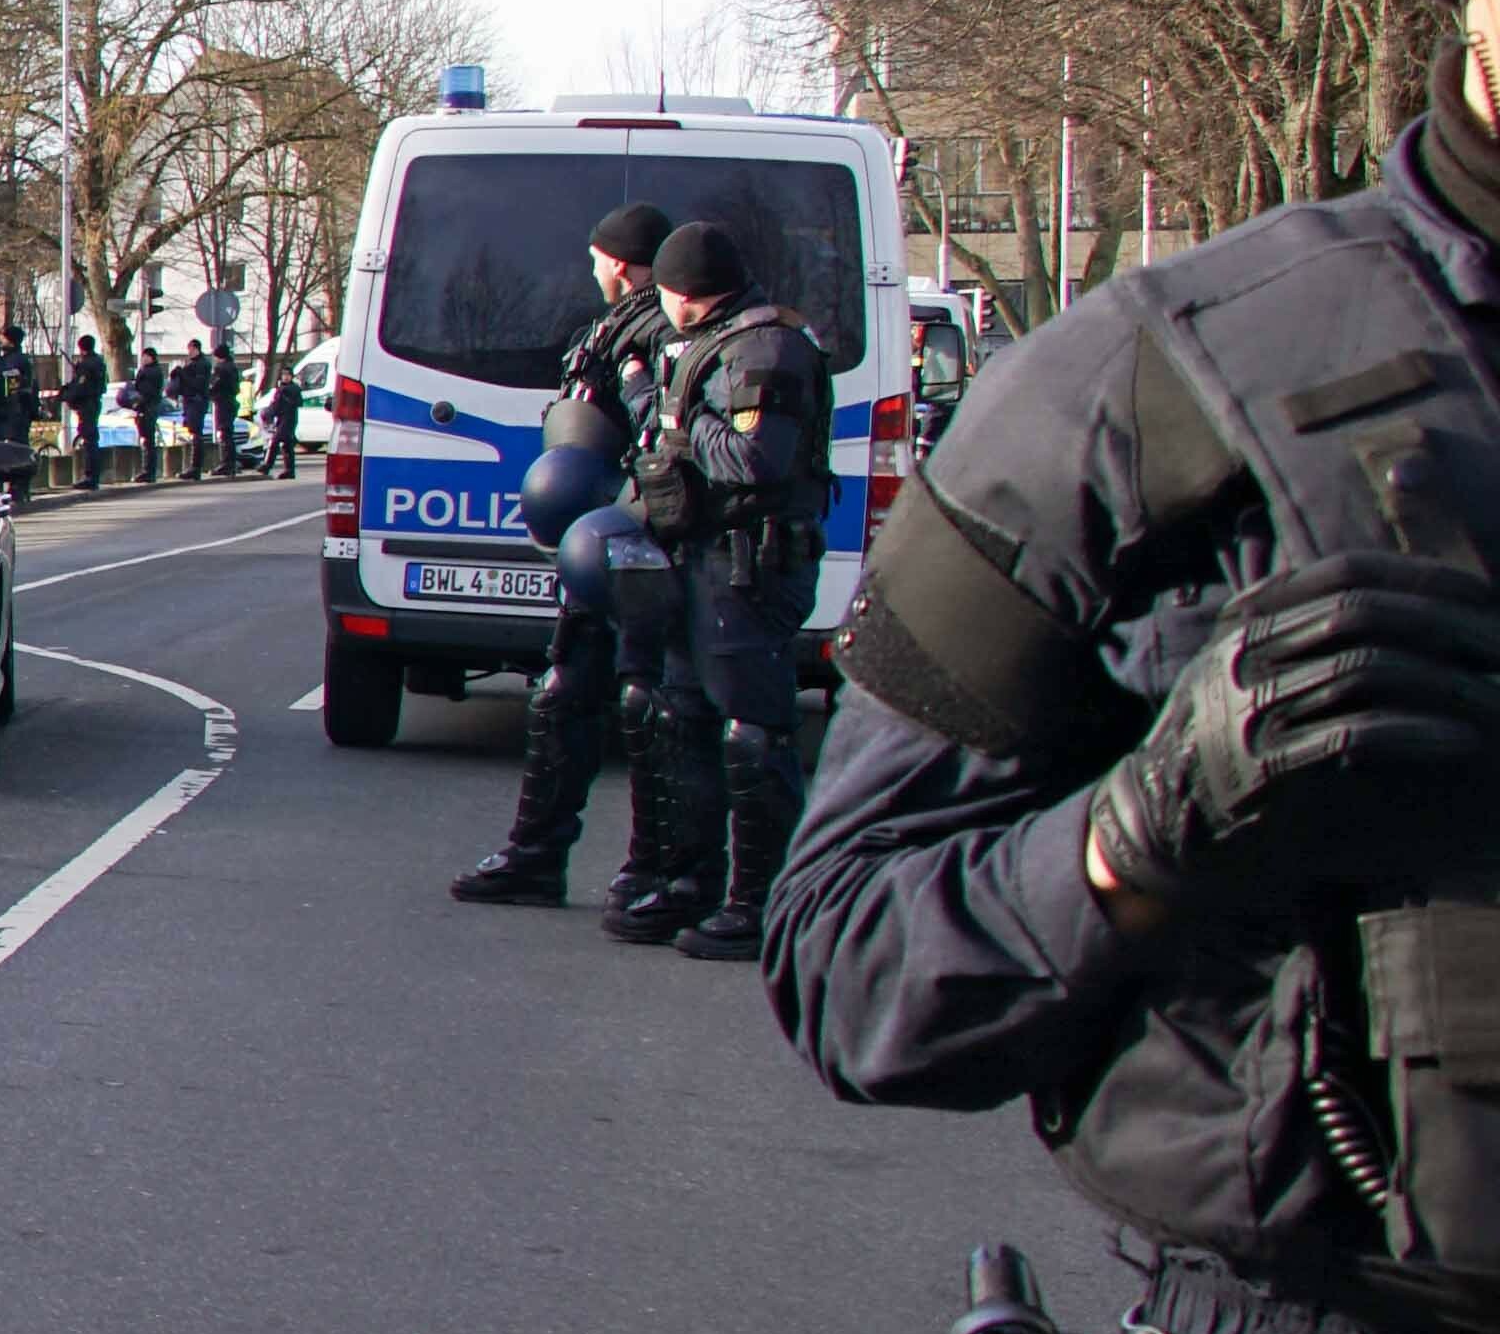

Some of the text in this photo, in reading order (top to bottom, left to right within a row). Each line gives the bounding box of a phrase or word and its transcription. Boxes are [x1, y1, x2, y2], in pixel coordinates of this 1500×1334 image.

[385, 487, 528, 530] POLIZ
[422, 569, 464, 592] BWL
[471, 571, 483, 594] 4
